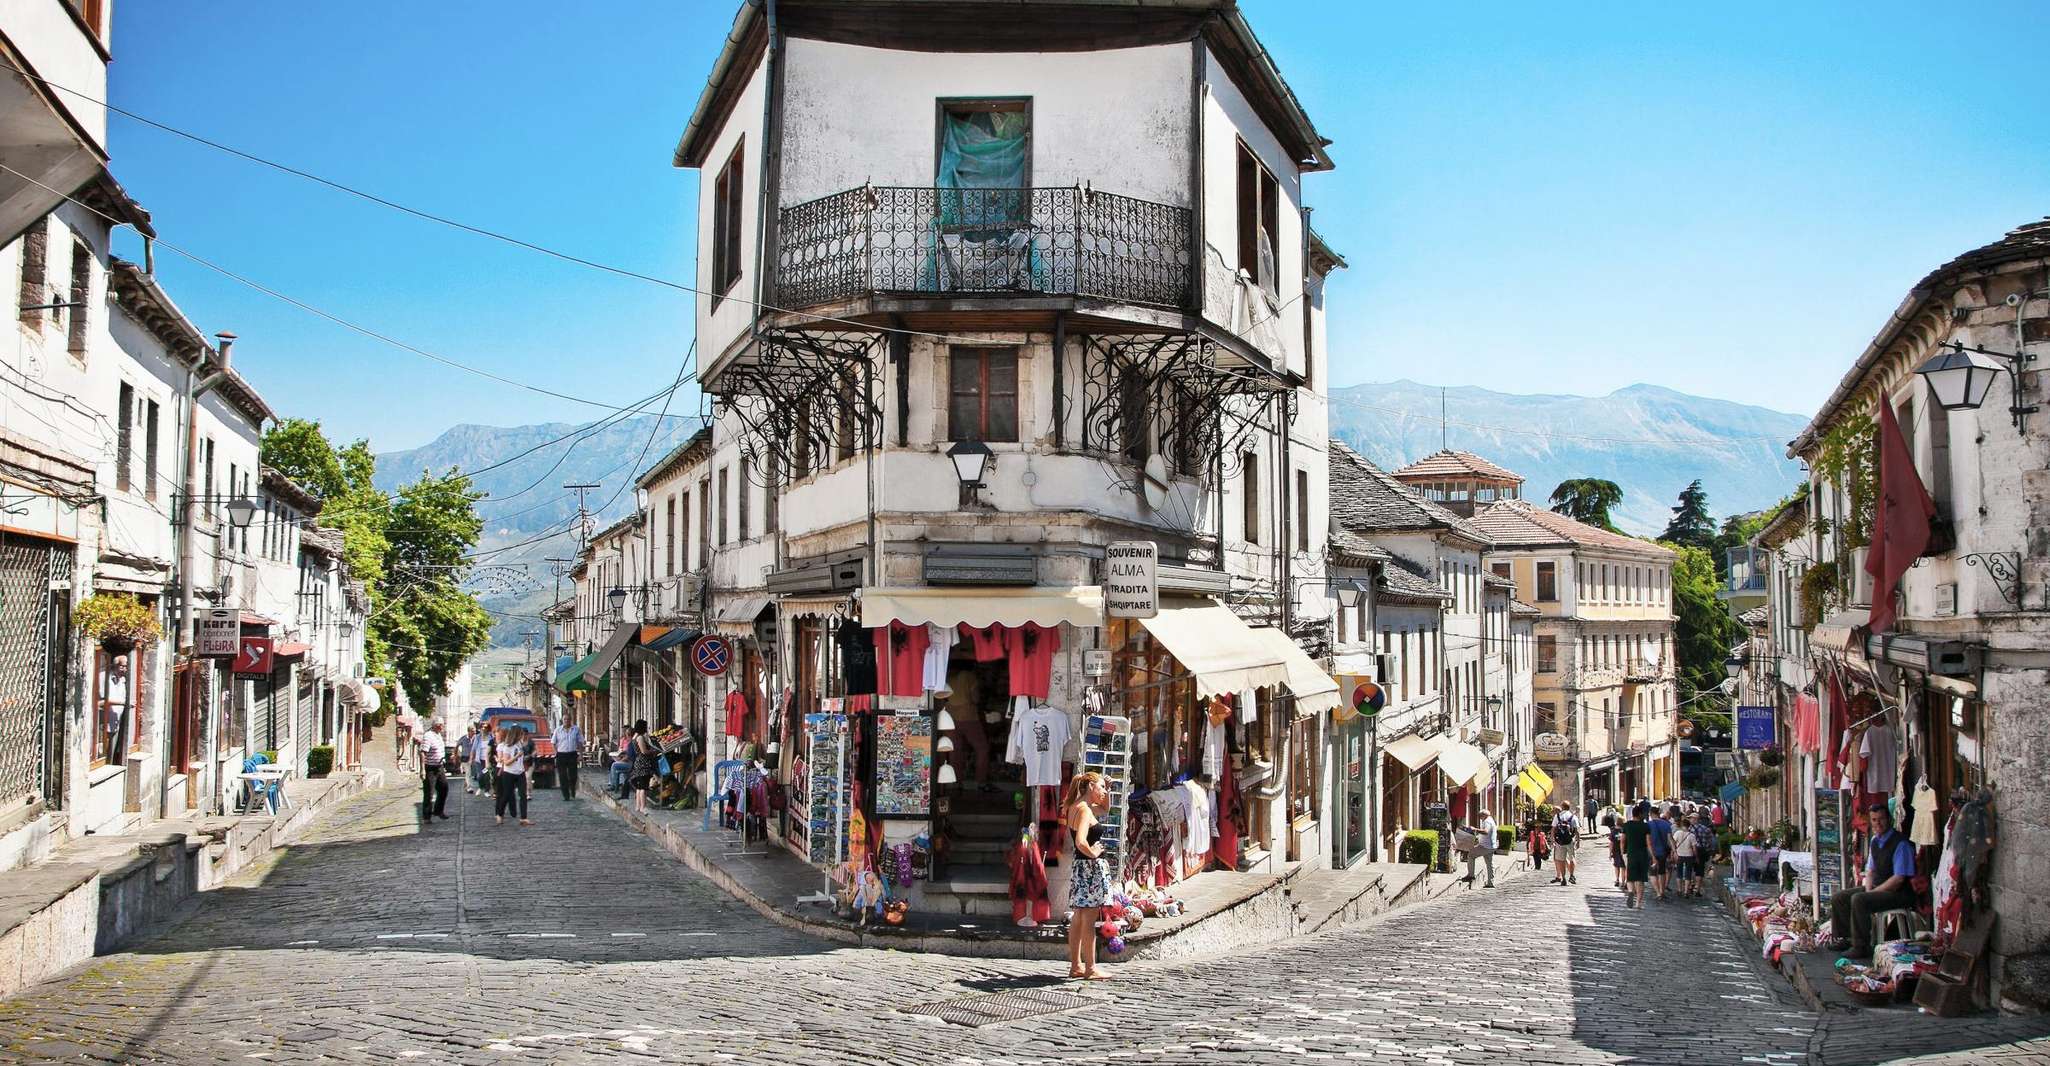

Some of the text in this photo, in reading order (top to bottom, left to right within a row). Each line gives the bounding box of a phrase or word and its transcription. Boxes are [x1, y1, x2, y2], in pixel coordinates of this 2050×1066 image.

[1108, 548, 1152, 558] SOUVENIR
[1111, 564, 1145, 576] ALMA
[1110, 585, 1148, 594] TRADITA
[1109, 600, 1152, 610] SHQIPTARE
